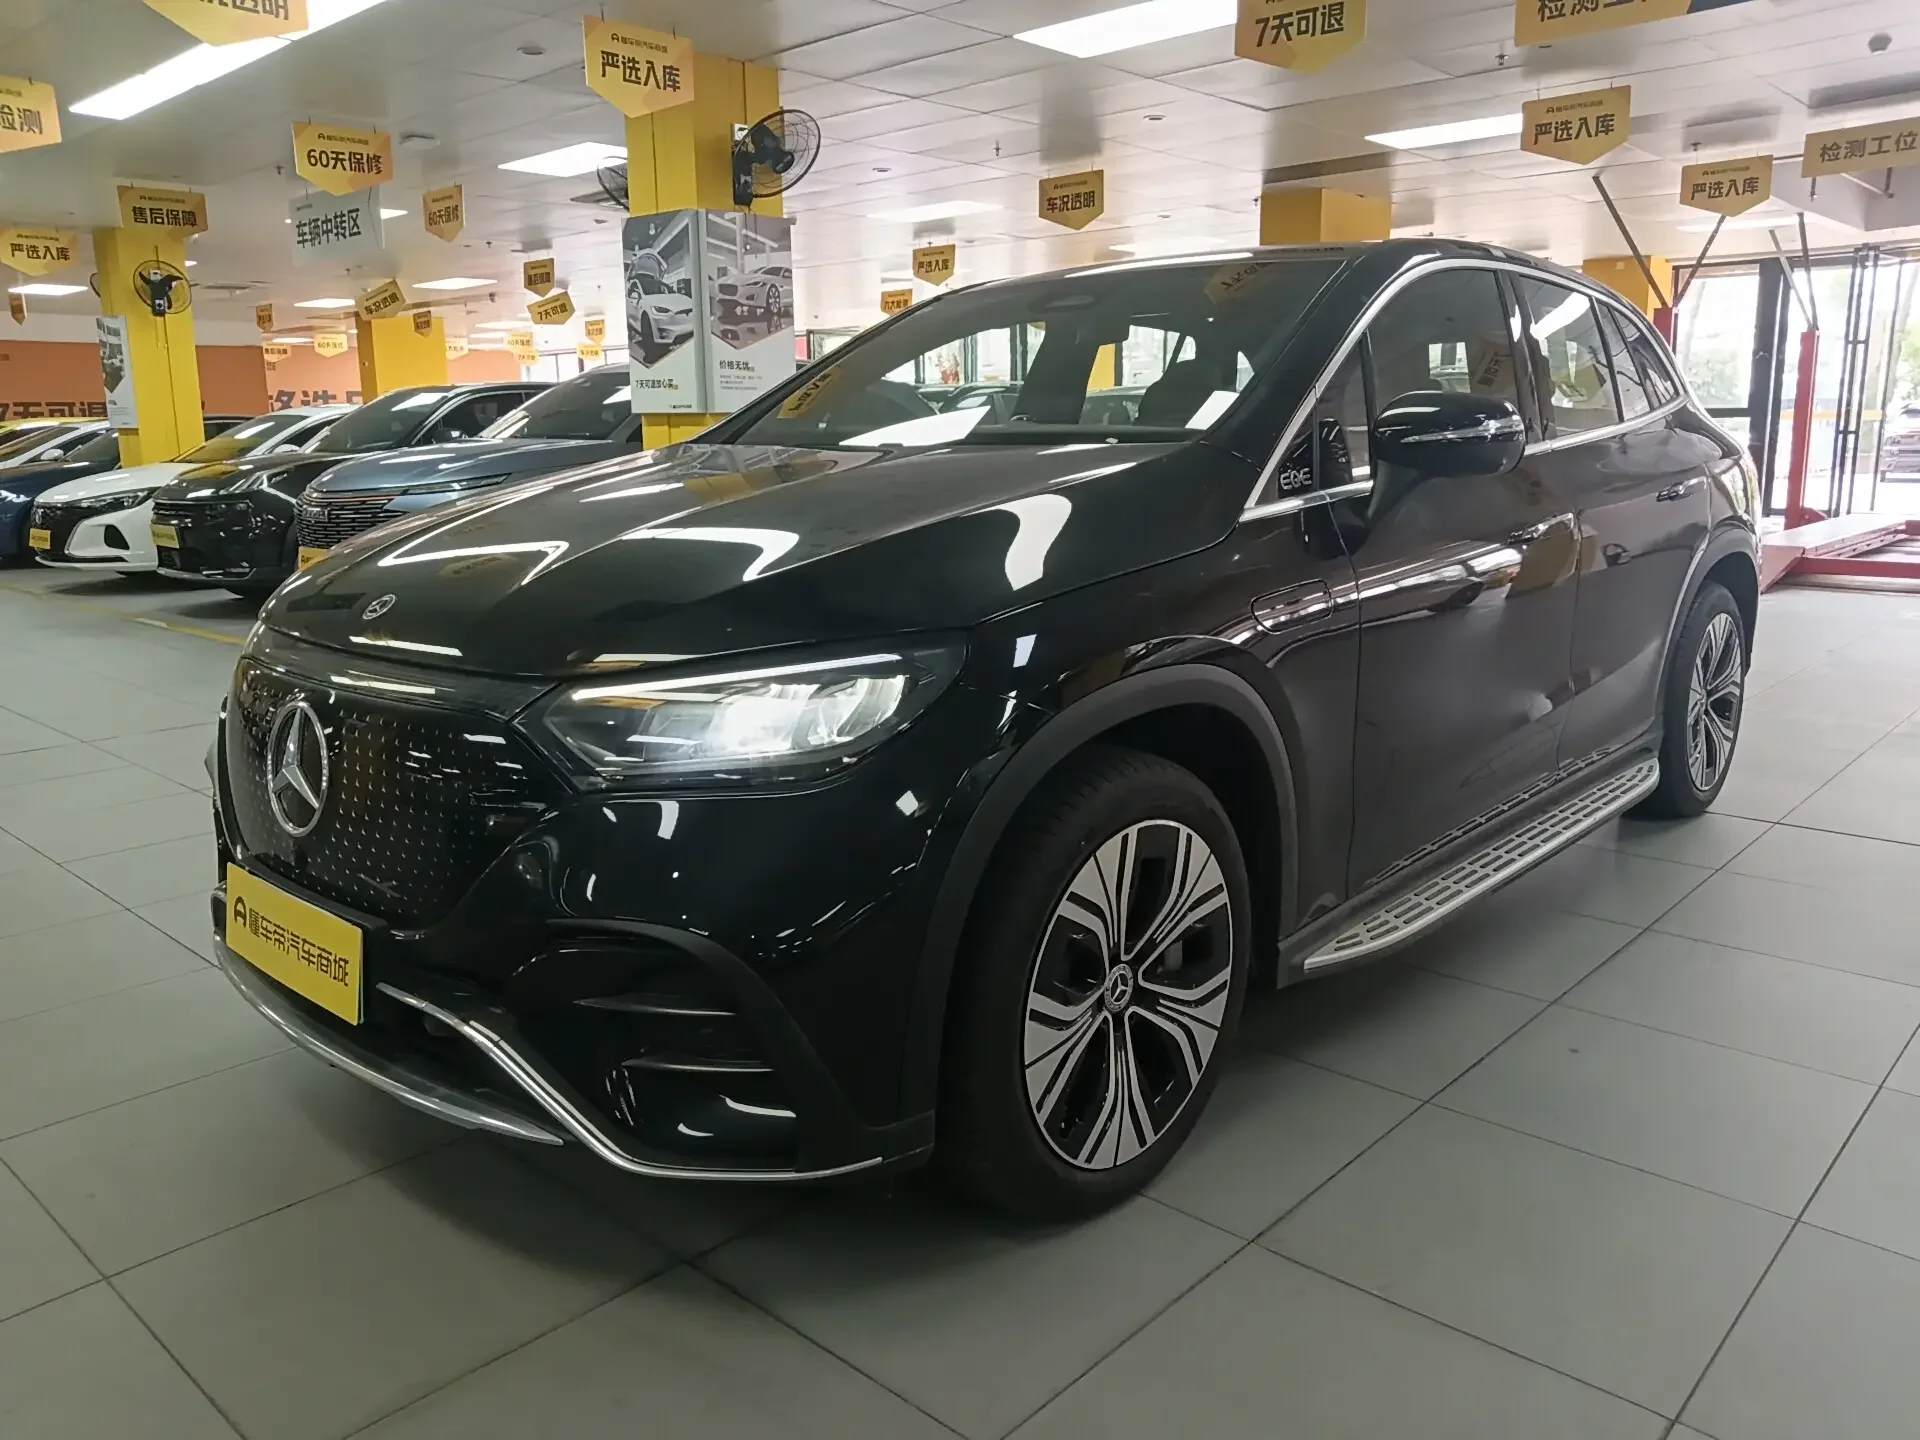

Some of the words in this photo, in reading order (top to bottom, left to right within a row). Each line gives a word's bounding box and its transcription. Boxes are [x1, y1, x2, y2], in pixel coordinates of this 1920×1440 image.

[1256, 1, 1344, 47] 7天可退
[601, 50, 681, 92] 严选入库
[1533, 113, 1615, 146] 严选入库
[1820, 130, 1919, 163] 检测工位
[306, 148, 383, 175] 60天保修
[1046, 190, 1096, 213] 车况透明
[1691, 176, 1760, 201] 严选入库
[132, 205, 198, 228] 售后保障
[296, 207, 362, 249] 车辆中转区
[10, 242, 71, 261] 严选入库
[917, 259, 950, 274] 严选入库
[537, 302, 569, 321] 7天可退
[719, 360, 750, 370] 价格无忧
[249, 907, 349, 987] 懂车帝汽车商城
